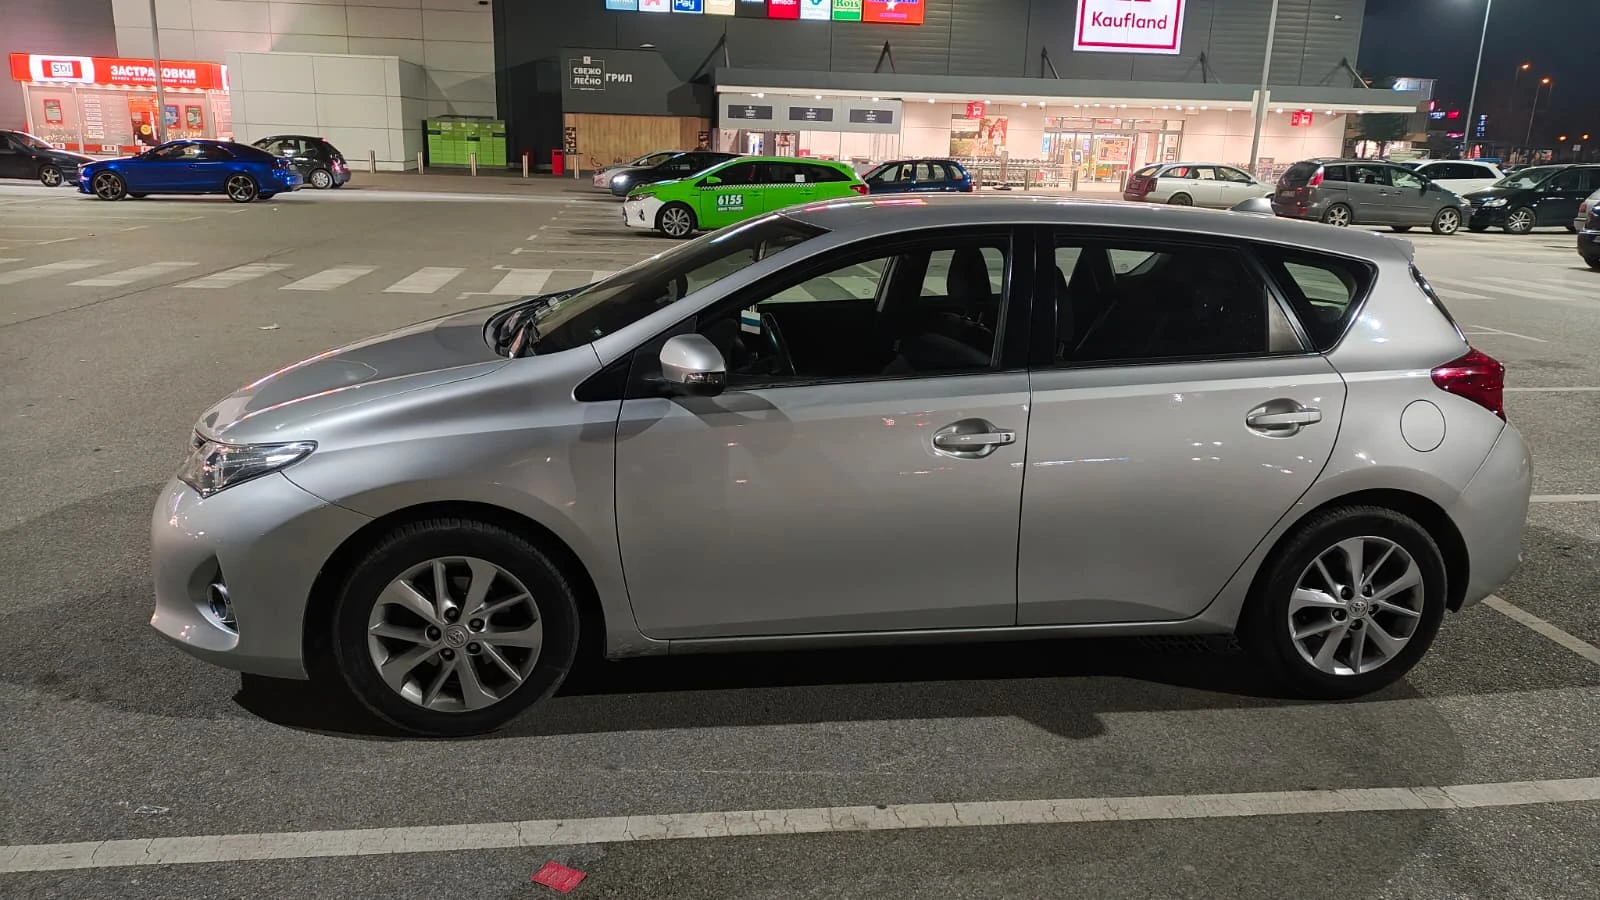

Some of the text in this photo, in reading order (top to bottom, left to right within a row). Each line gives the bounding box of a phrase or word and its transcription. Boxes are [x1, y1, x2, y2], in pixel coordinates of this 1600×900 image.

[1091, 11, 1168, 30] Kaufland
[53, 64, 71, 73] SDI
[110, 65, 196, 79] ЗАСТРАОВКИ
[573, 67, 602, 75] СВЕЖО
[574, 77, 602, 85] ЛЕСНО
[605, 73, 633, 83] ГРИЛ
[718, 194, 742, 205] 6155
